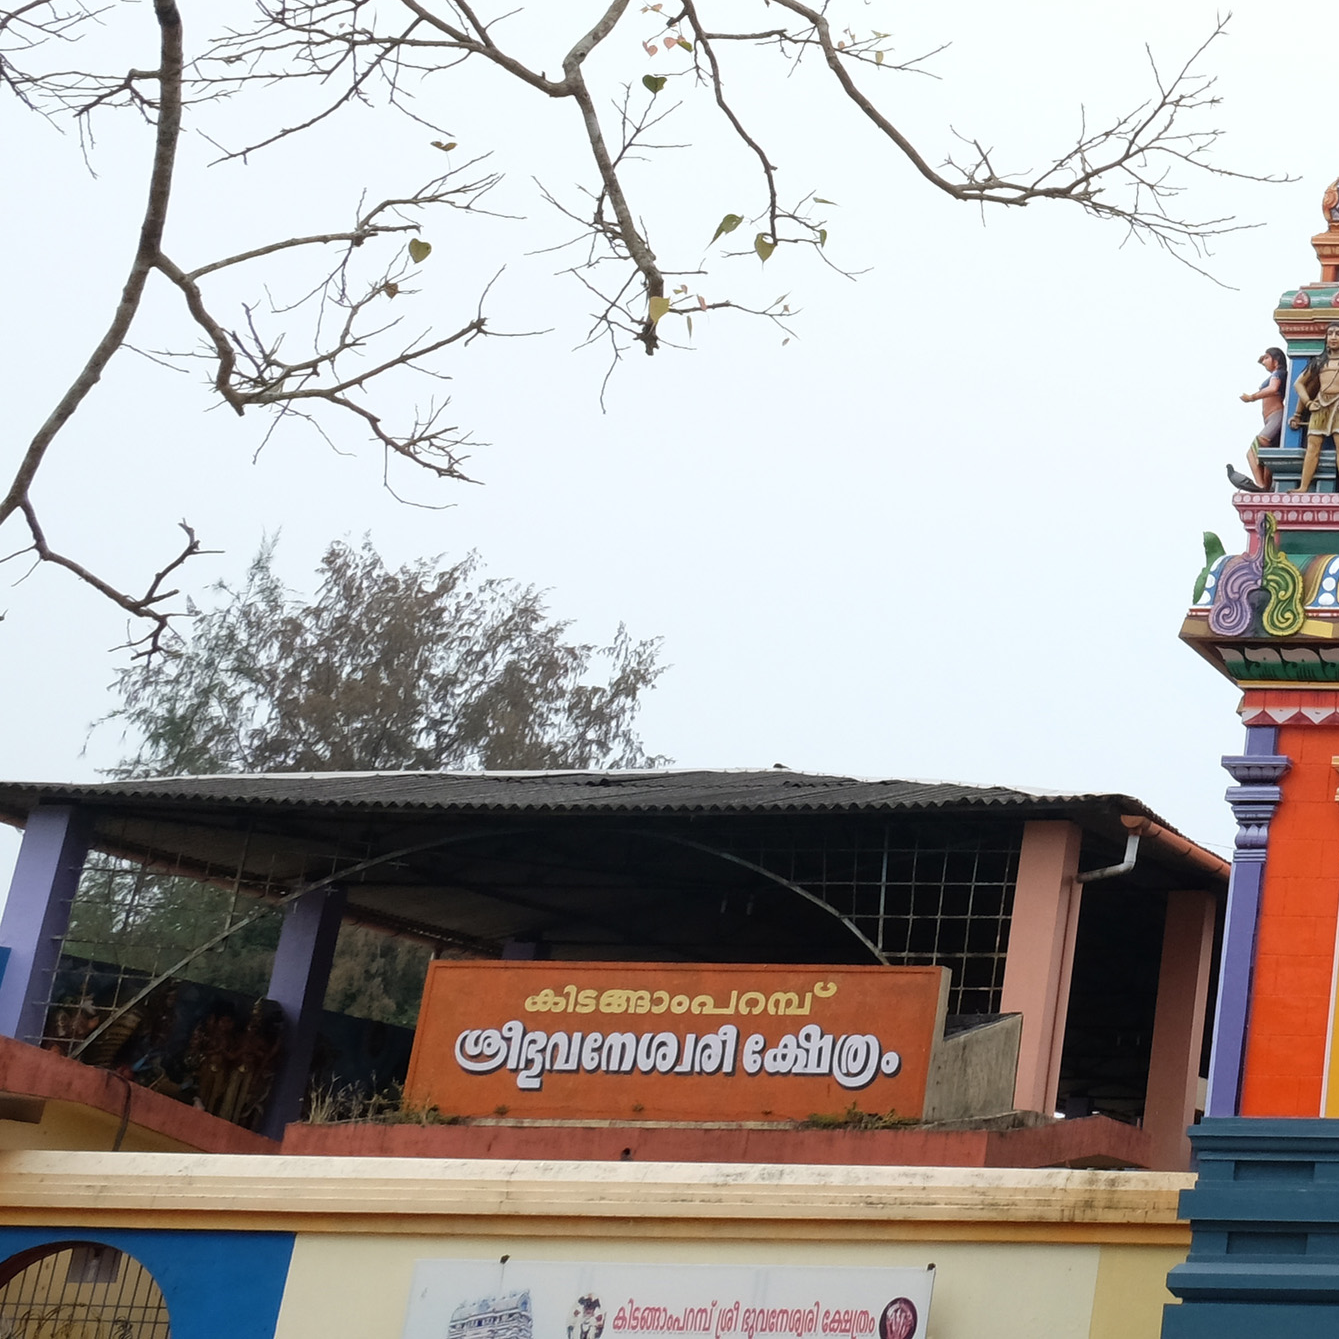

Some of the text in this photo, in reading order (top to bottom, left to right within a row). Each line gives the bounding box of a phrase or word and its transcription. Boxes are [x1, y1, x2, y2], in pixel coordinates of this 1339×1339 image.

[524, 981, 838, 1016] കിടങ്ങാംപറമ്പ്
[743, 1023, 900, 1088] ക്ഷേത്രം
[612, 1298, 718, 1333] കിടങ്ങാംപറമ്പ്
[715, 1301, 741, 1339] ശ്രീ
[821, 1309, 876, 1339] ക്ഷേത്രം
